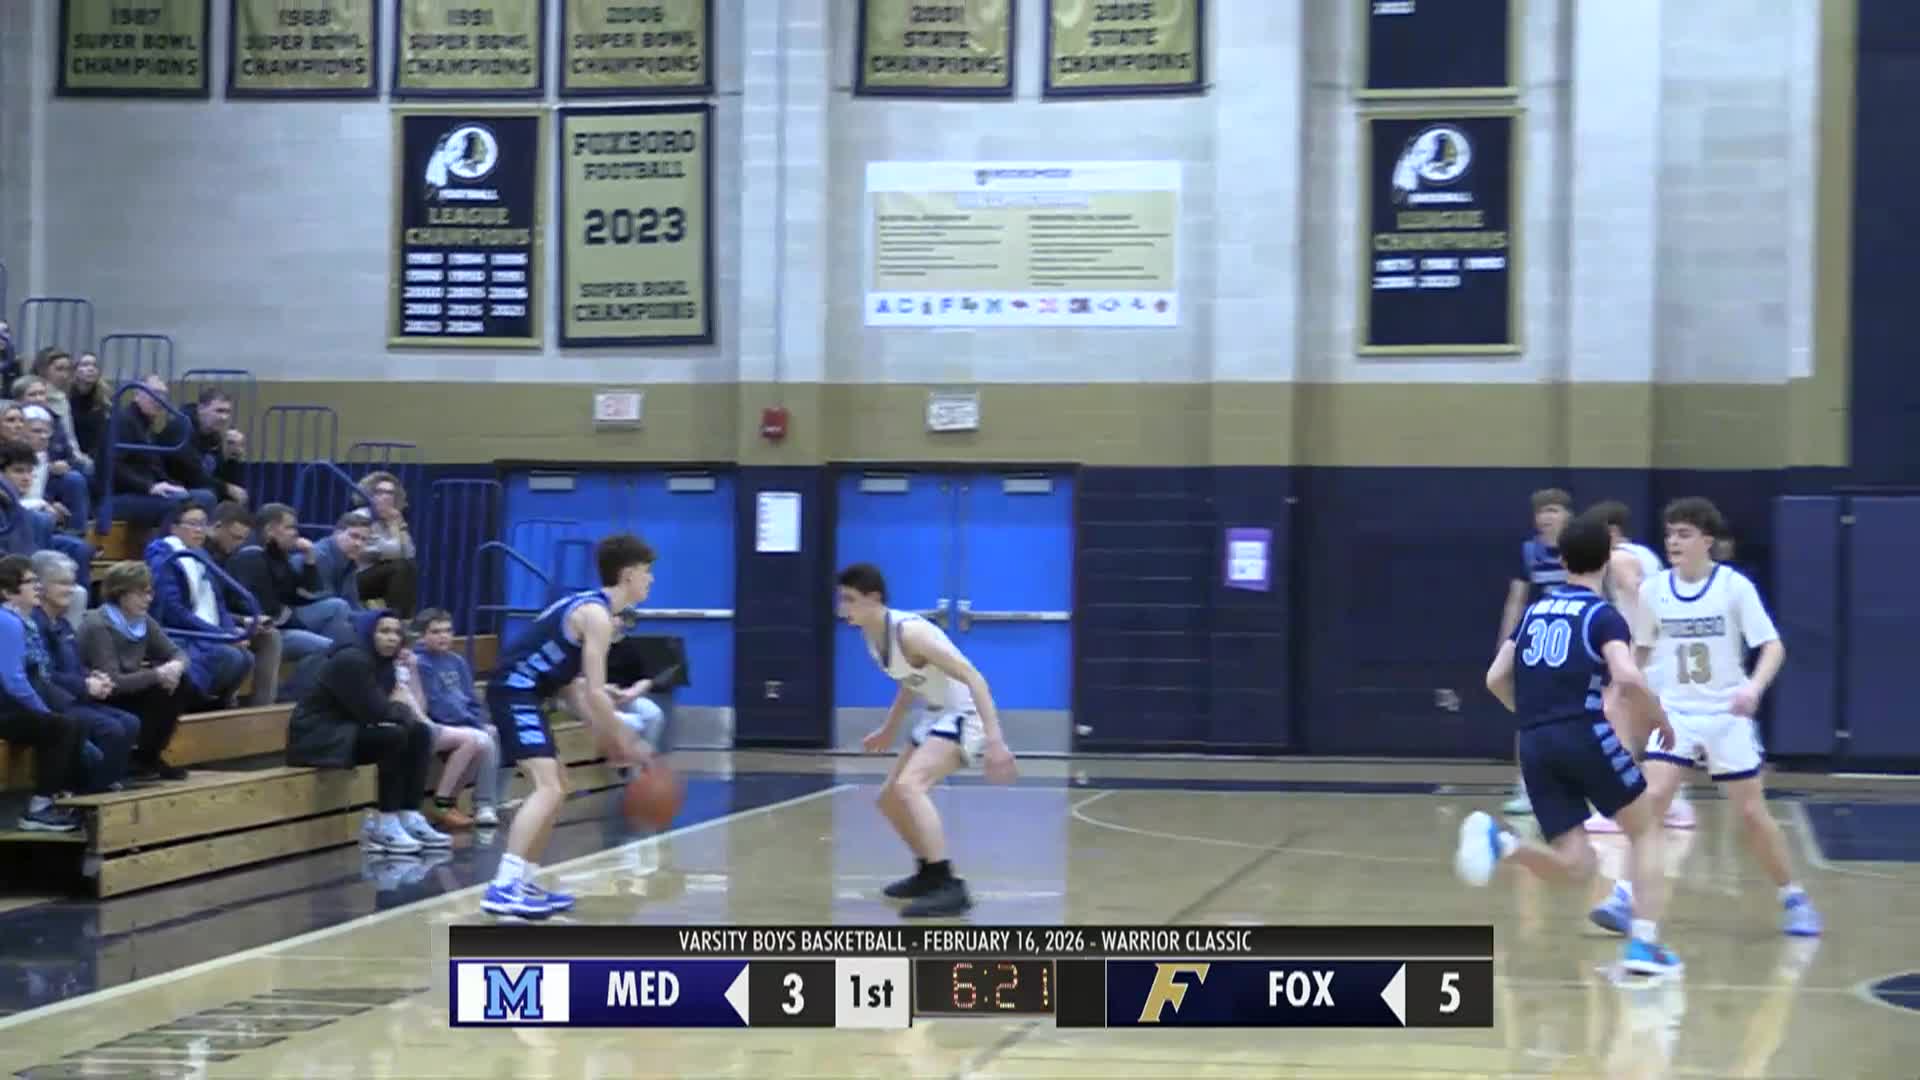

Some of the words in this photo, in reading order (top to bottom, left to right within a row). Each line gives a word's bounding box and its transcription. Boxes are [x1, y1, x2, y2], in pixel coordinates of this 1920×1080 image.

[73, 33, 136, 49] SUPER
[143, 33, 196, 49] BOWL
[245, 34, 304, 49] SUPER
[311, 35, 364, 50] BOWL
[409, 33, 469, 49] SUPER
[574, 33, 635, 49] SUPER
[72, 58, 198, 75] CHAMPIONS
[242, 58, 367, 75] CHAMPIONS
[407, 58, 531, 74] CHAMPIONS
[572, 56, 699, 73] CHAMPIONS
[872, 56, 1000, 73] CHAMPIONS
[1057, 54, 1188, 72] CHAMPIONS
[573, 130, 696, 155] FOXBORO
[584, 207, 686, 245] 2023
[1522, 617, 1572, 667] 30
[1676, 643, 1711, 684] 13
